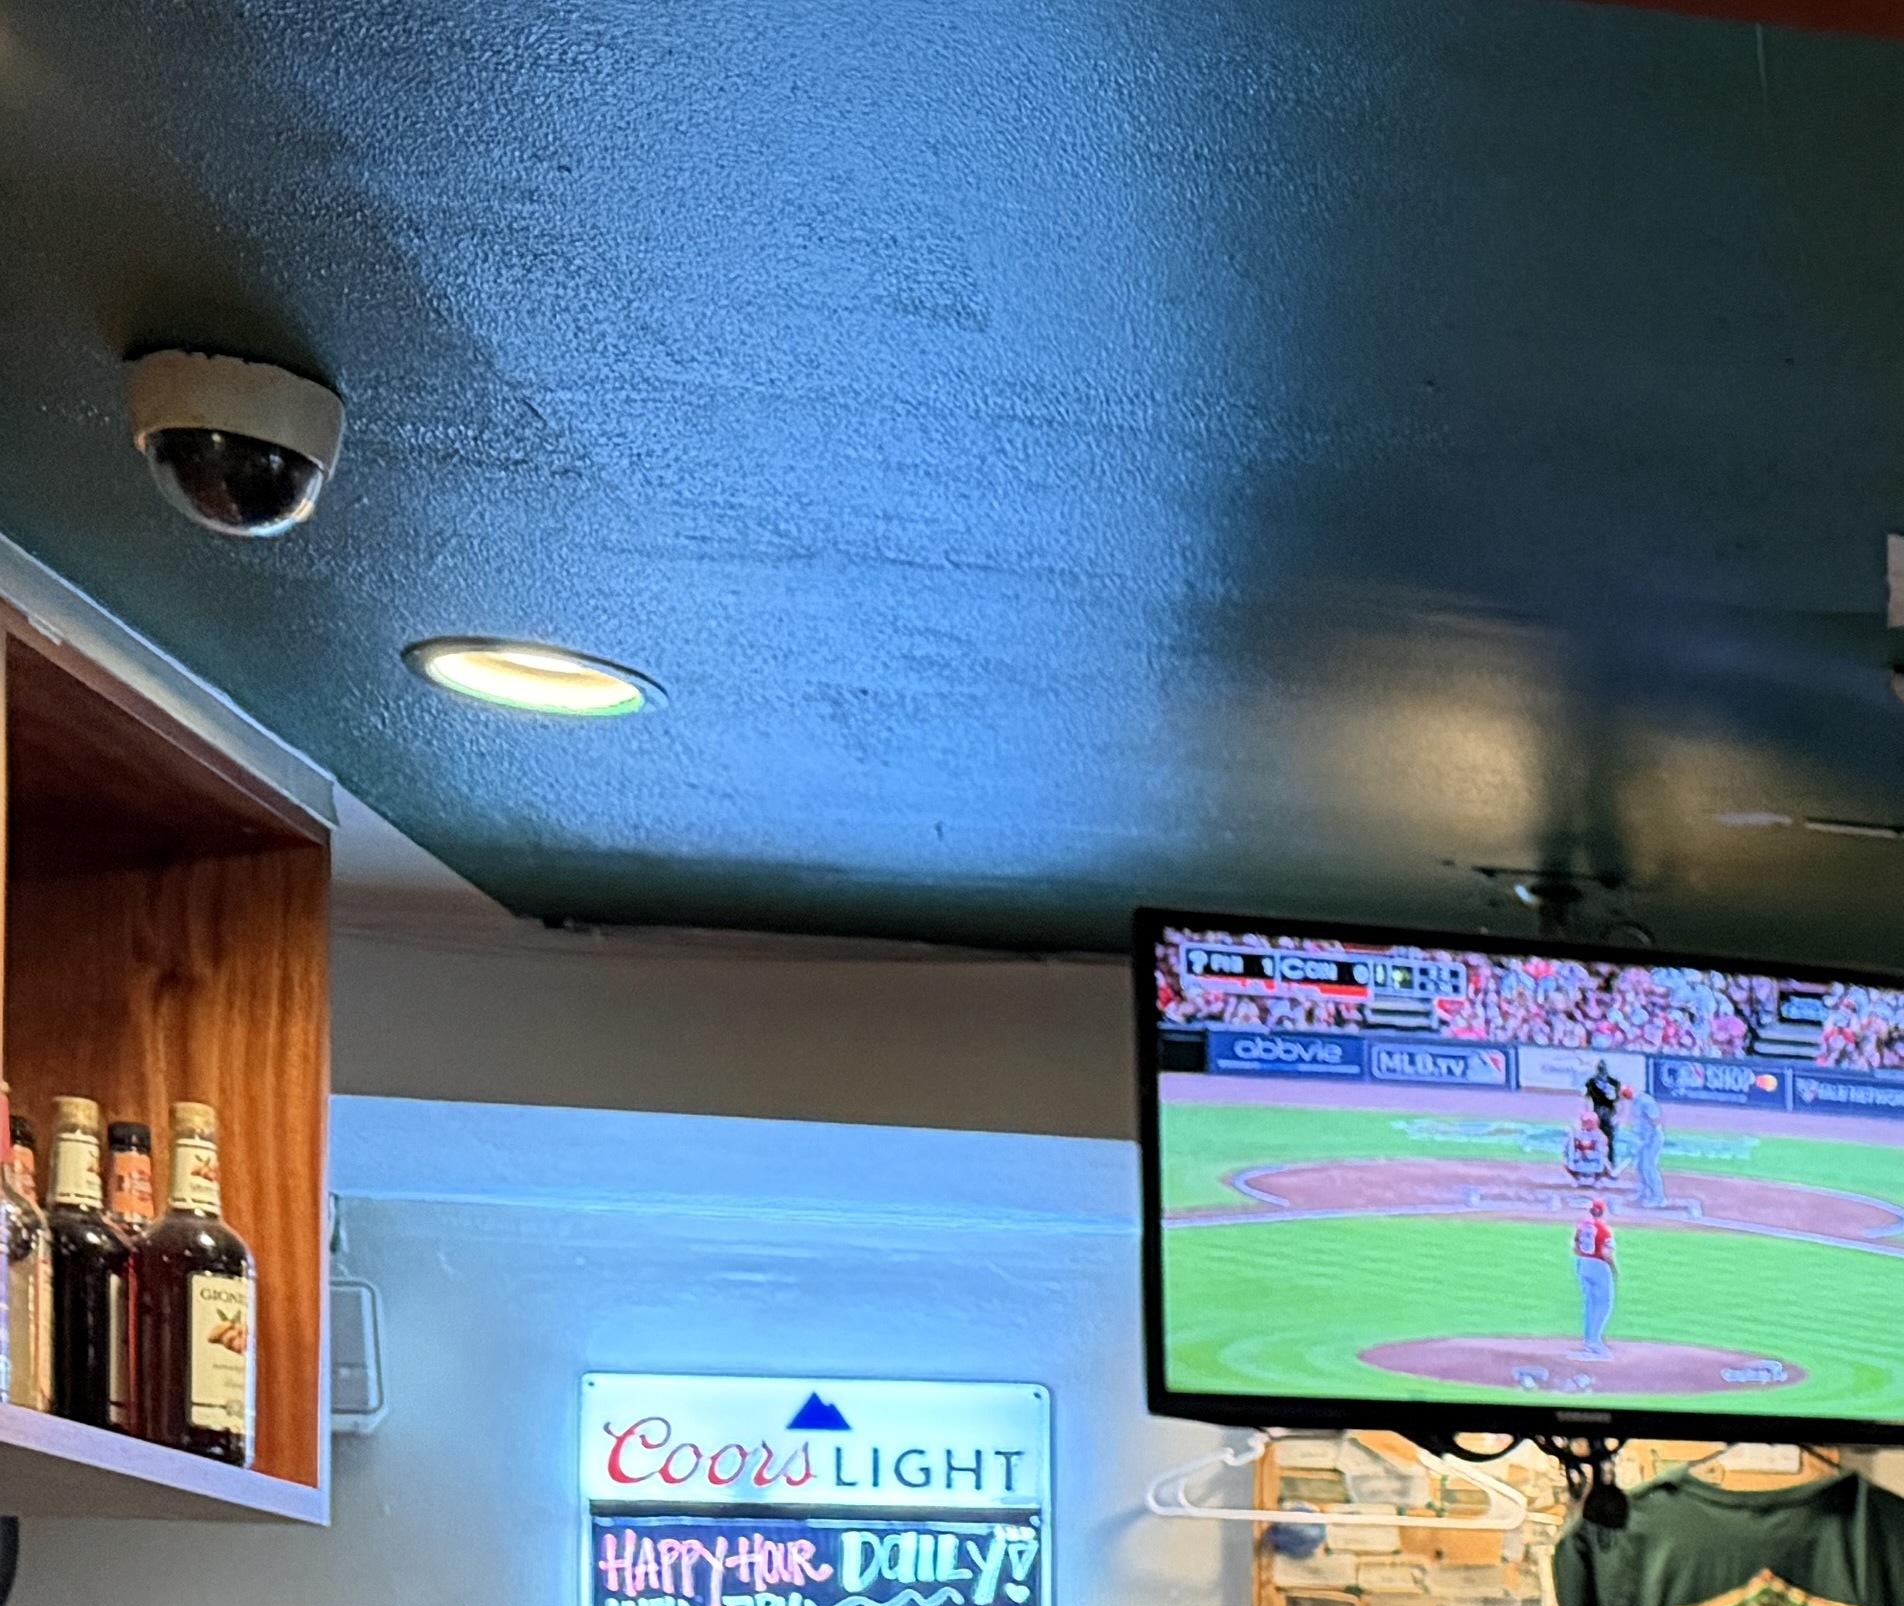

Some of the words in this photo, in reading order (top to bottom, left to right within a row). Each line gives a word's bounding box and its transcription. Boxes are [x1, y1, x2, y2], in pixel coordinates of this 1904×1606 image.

[1232, 1036, 1344, 1064] abbvie
[603, 1416, 819, 1488] Coors
[834, 1446, 1025, 1492] LIGHT
[725, 1532, 834, 1592] HOUR
